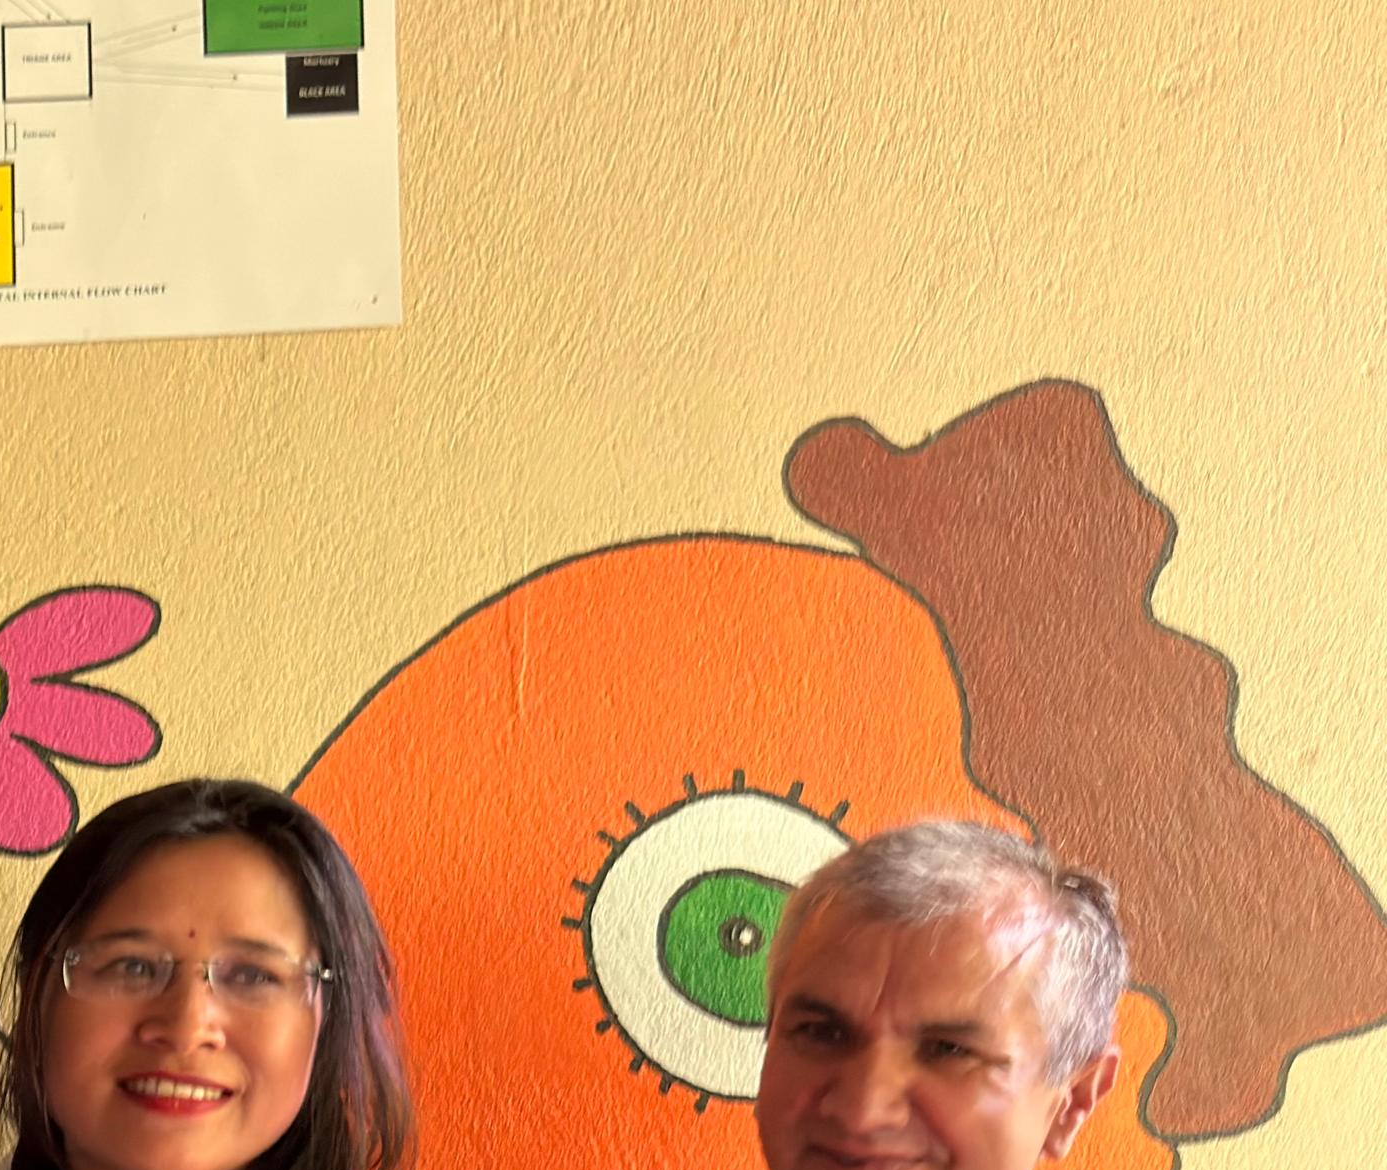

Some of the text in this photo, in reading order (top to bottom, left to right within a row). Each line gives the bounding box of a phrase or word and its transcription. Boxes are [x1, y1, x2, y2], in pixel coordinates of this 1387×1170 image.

[23, 288, 82, 301] INTERNAL
[87, 285, 121, 297] FLOW
[124, 284, 167, 296] CHART
